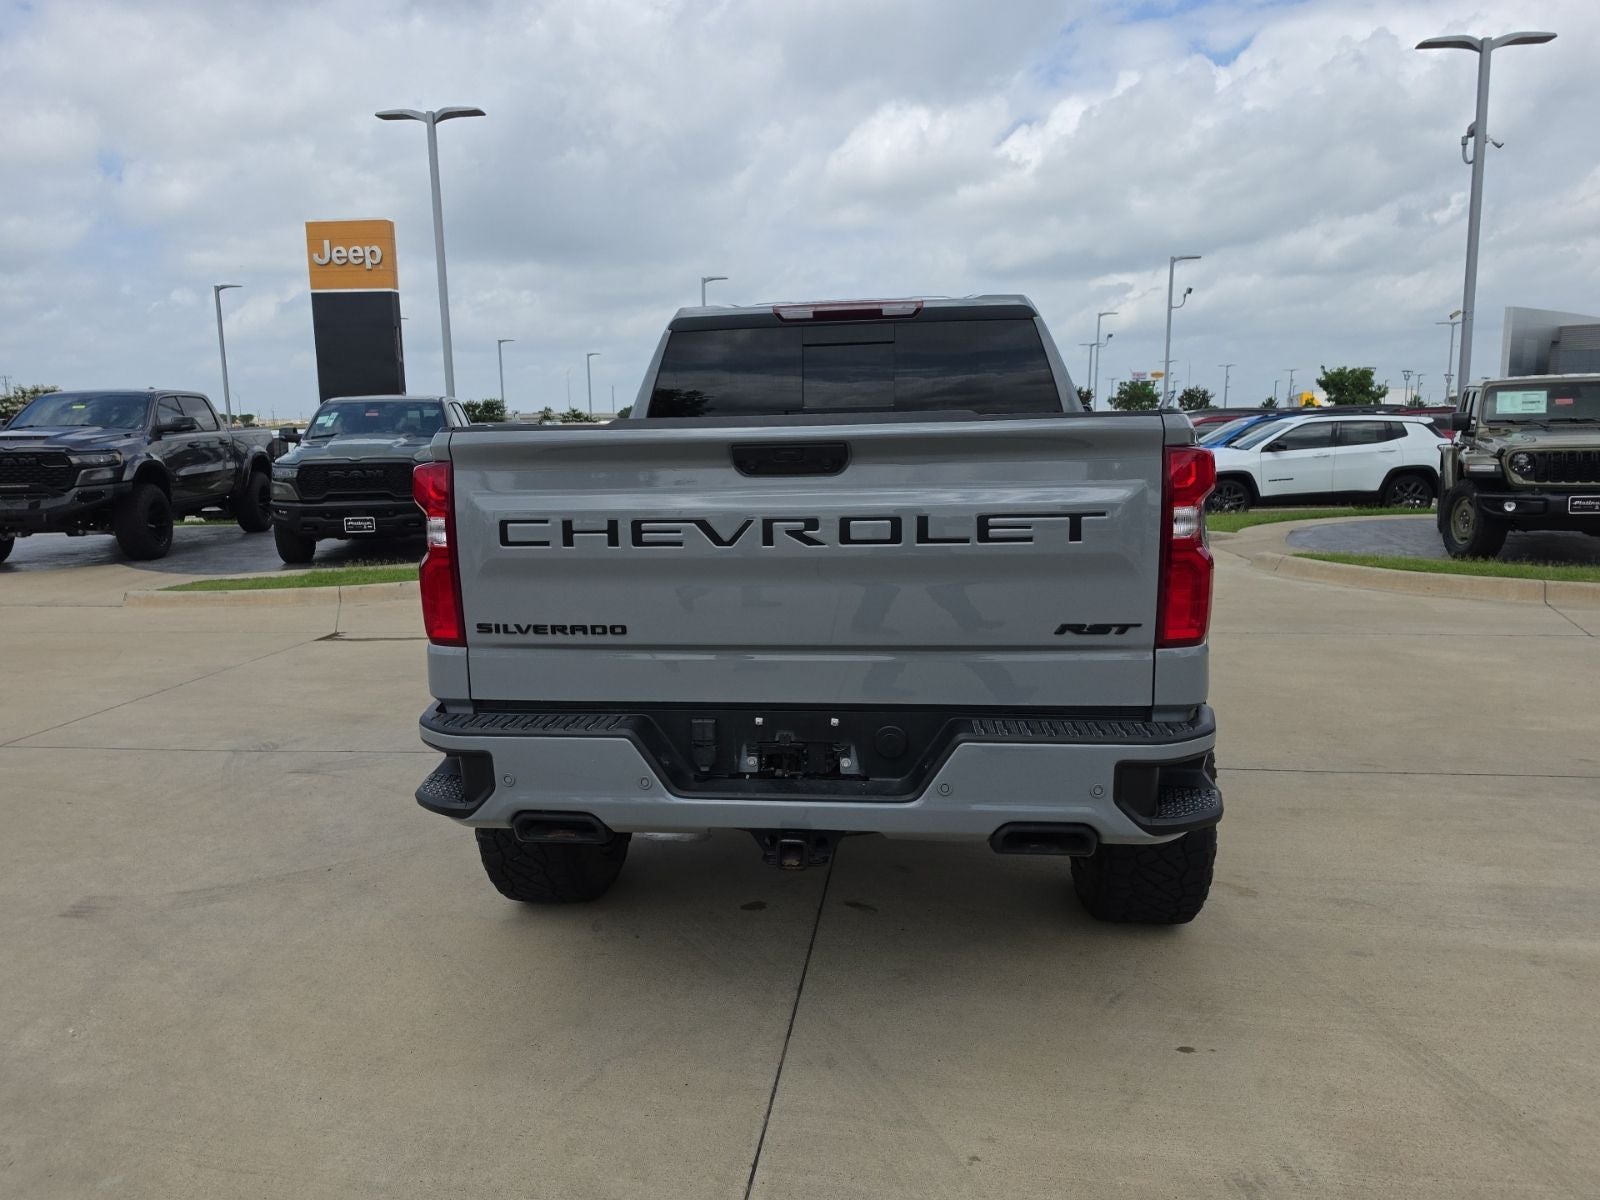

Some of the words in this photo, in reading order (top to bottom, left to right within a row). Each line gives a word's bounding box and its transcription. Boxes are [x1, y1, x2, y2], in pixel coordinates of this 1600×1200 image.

[313, 239, 382, 270] Jeep
[328, 470, 384, 478] RAM
[499, 511, 1107, 547] CHEVROLET
[476, 622, 627, 636] SILVERADO
[1054, 623, 1143, 635] RST
